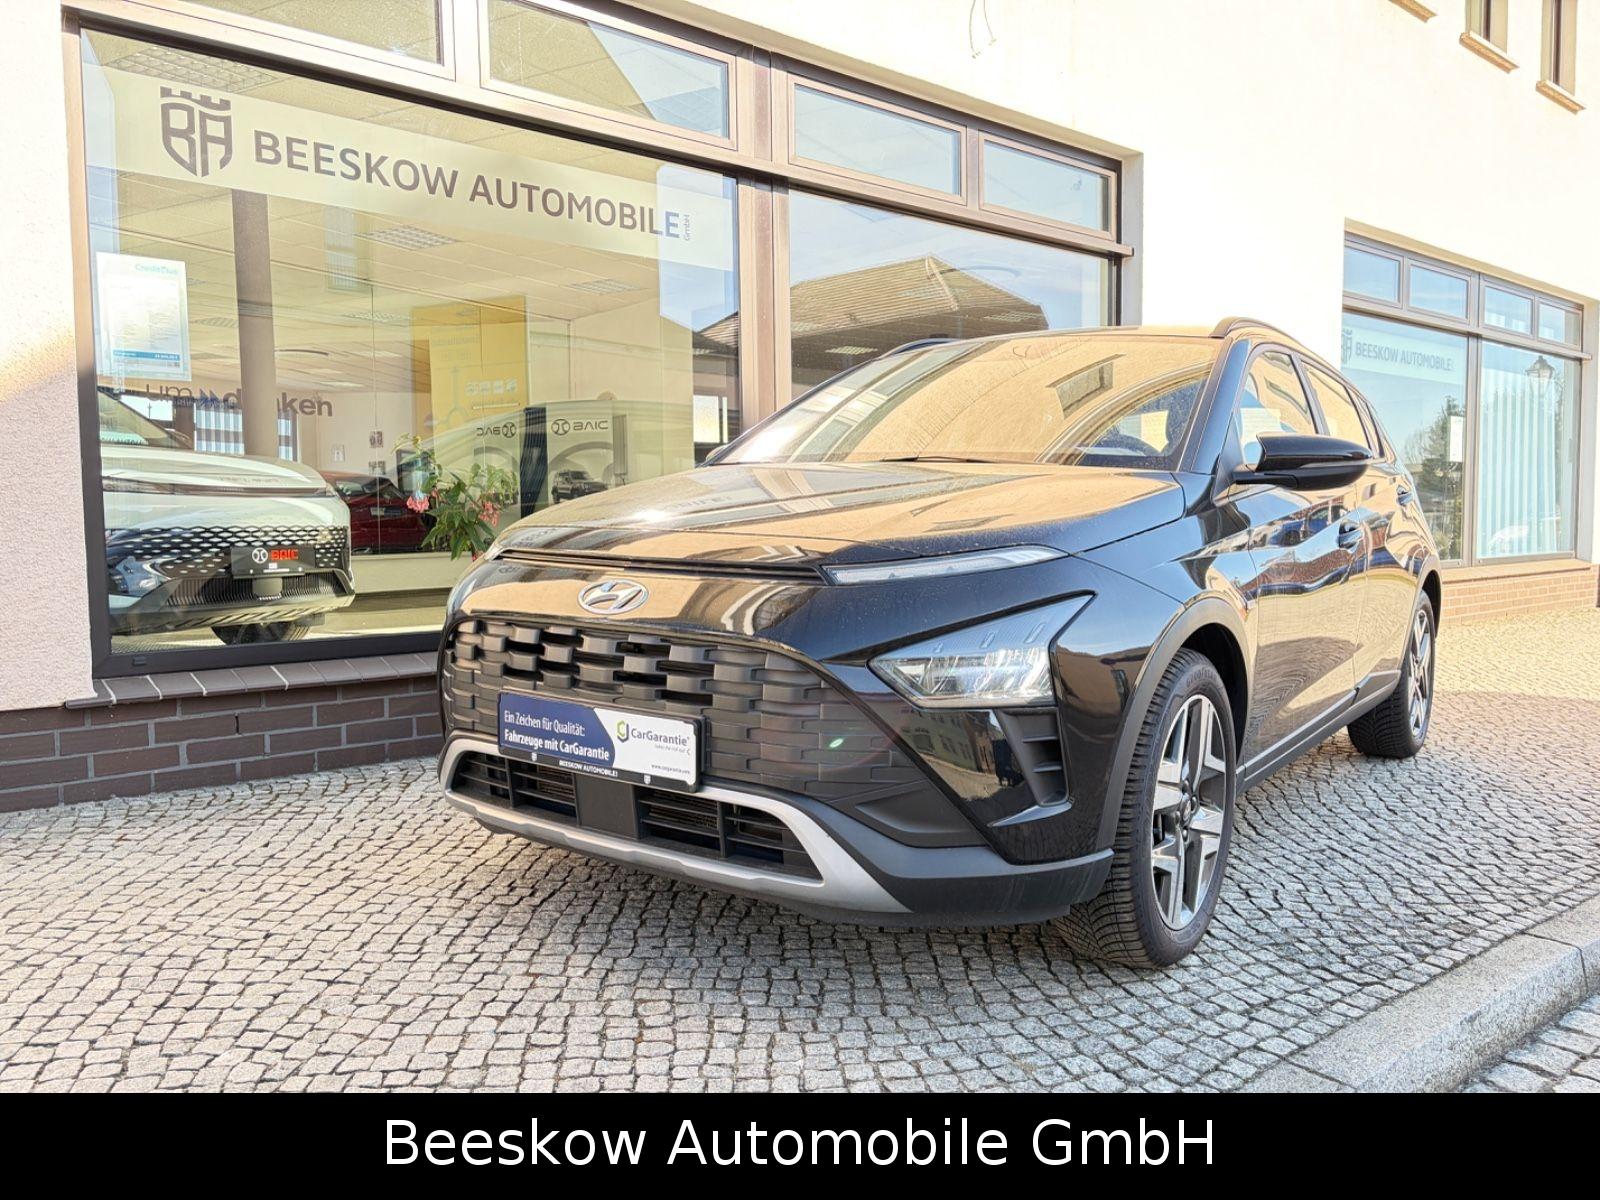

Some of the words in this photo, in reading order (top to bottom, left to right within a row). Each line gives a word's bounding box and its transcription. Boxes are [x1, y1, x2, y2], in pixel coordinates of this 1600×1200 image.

[253, 129, 459, 199] BEESKOW
[468, 174, 680, 239] AUTOMOBILE
[1355, 342, 1399, 363] BEESKOW
[1400, 350, 1453, 371] AUTOMOBILE
[573, 420, 609, 431] BAIC
[270, 548, 299, 561] BAIC
[504, 710, 516, 724] Ein
[515, 712, 541, 729] Zeichen
[542, 717, 553, 731] für
[554, 719, 586, 737] Qualität:
[504, 728, 544, 750] Fahrzeuge
[545, 738, 559, 753] mit
[560, 740, 610, 761] CarGarantie
[559, 760, 582, 770] BEESKOW
